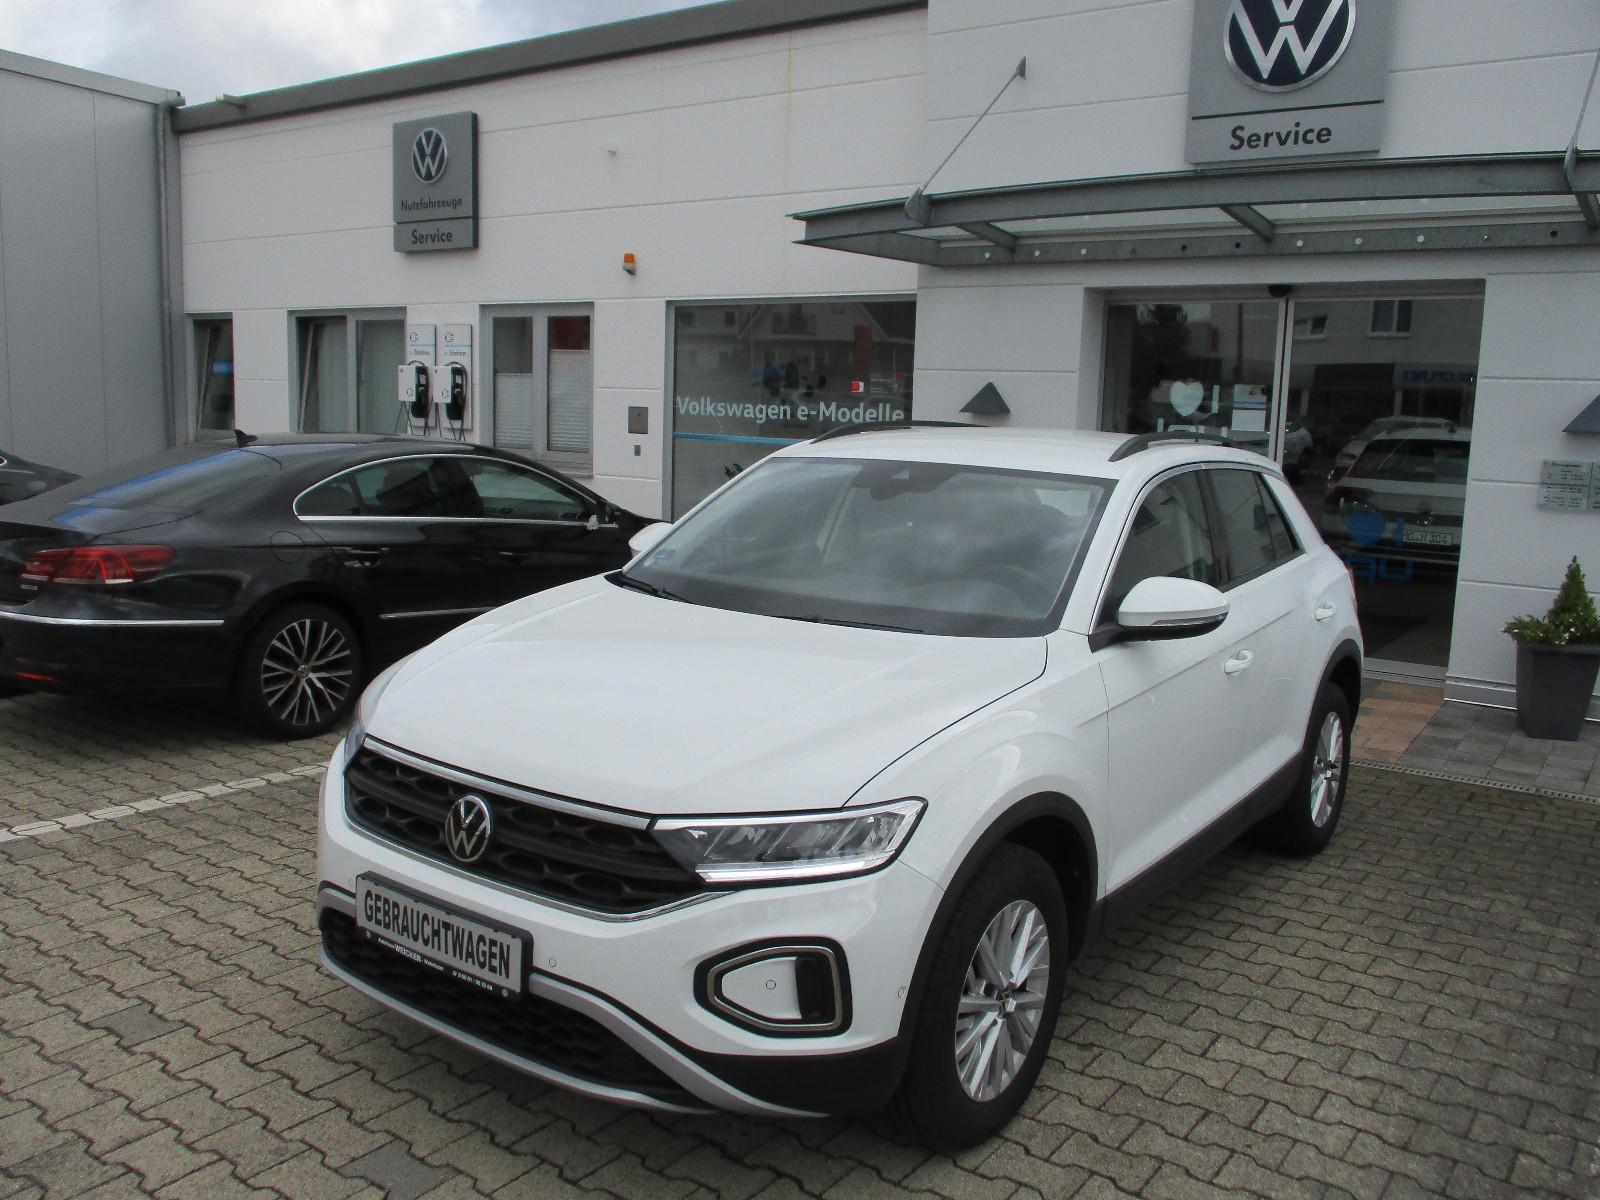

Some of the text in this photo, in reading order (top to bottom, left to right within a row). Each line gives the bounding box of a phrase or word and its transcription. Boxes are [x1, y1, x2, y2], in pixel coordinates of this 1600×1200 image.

[1229, 122, 1332, 150] Service
[401, 197, 463, 211] Nutzfahrzeuge
[411, 228, 453, 244] Service
[676, 396, 905, 424] Volkswagen e-Modelle
[364, 889, 511, 980] GEBRAUCHTWAGEN
